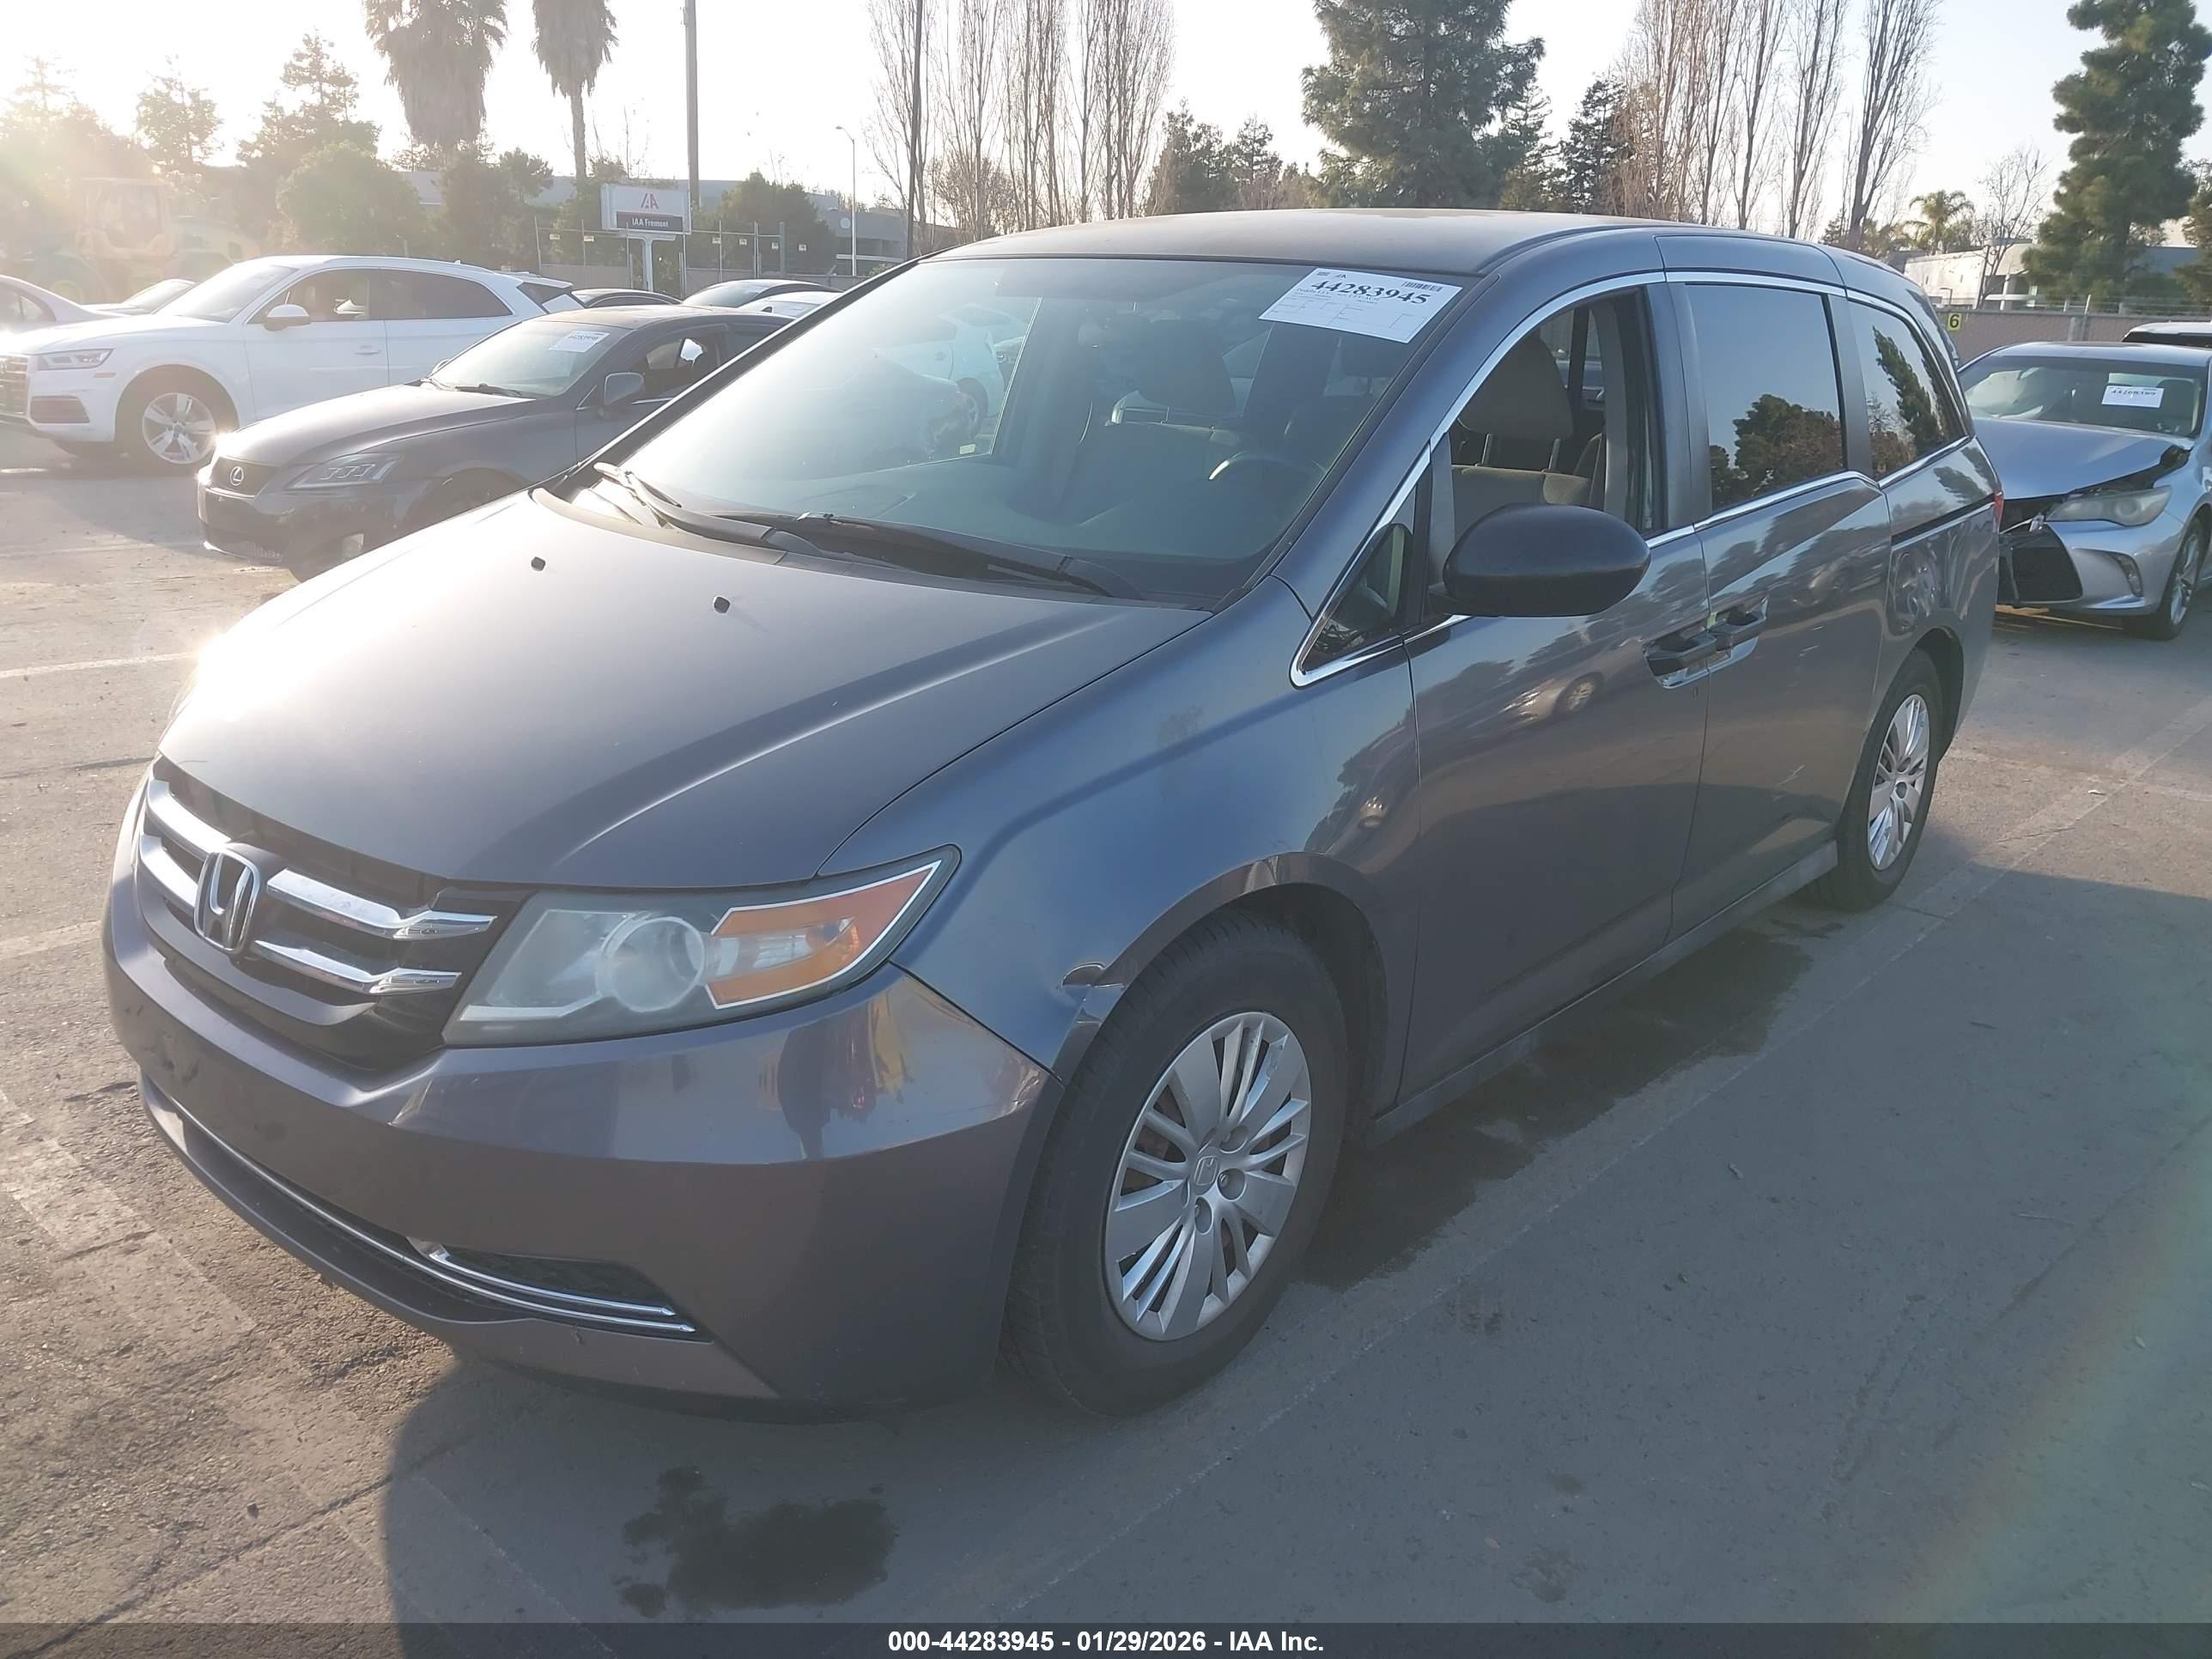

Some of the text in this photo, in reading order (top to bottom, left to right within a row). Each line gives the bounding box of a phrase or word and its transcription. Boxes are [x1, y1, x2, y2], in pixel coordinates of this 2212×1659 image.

[632, 217, 669, 228] IAA Fremont
[1311, 280, 1431, 305] 44283945
[1949, 313, 1960, 328] 6
